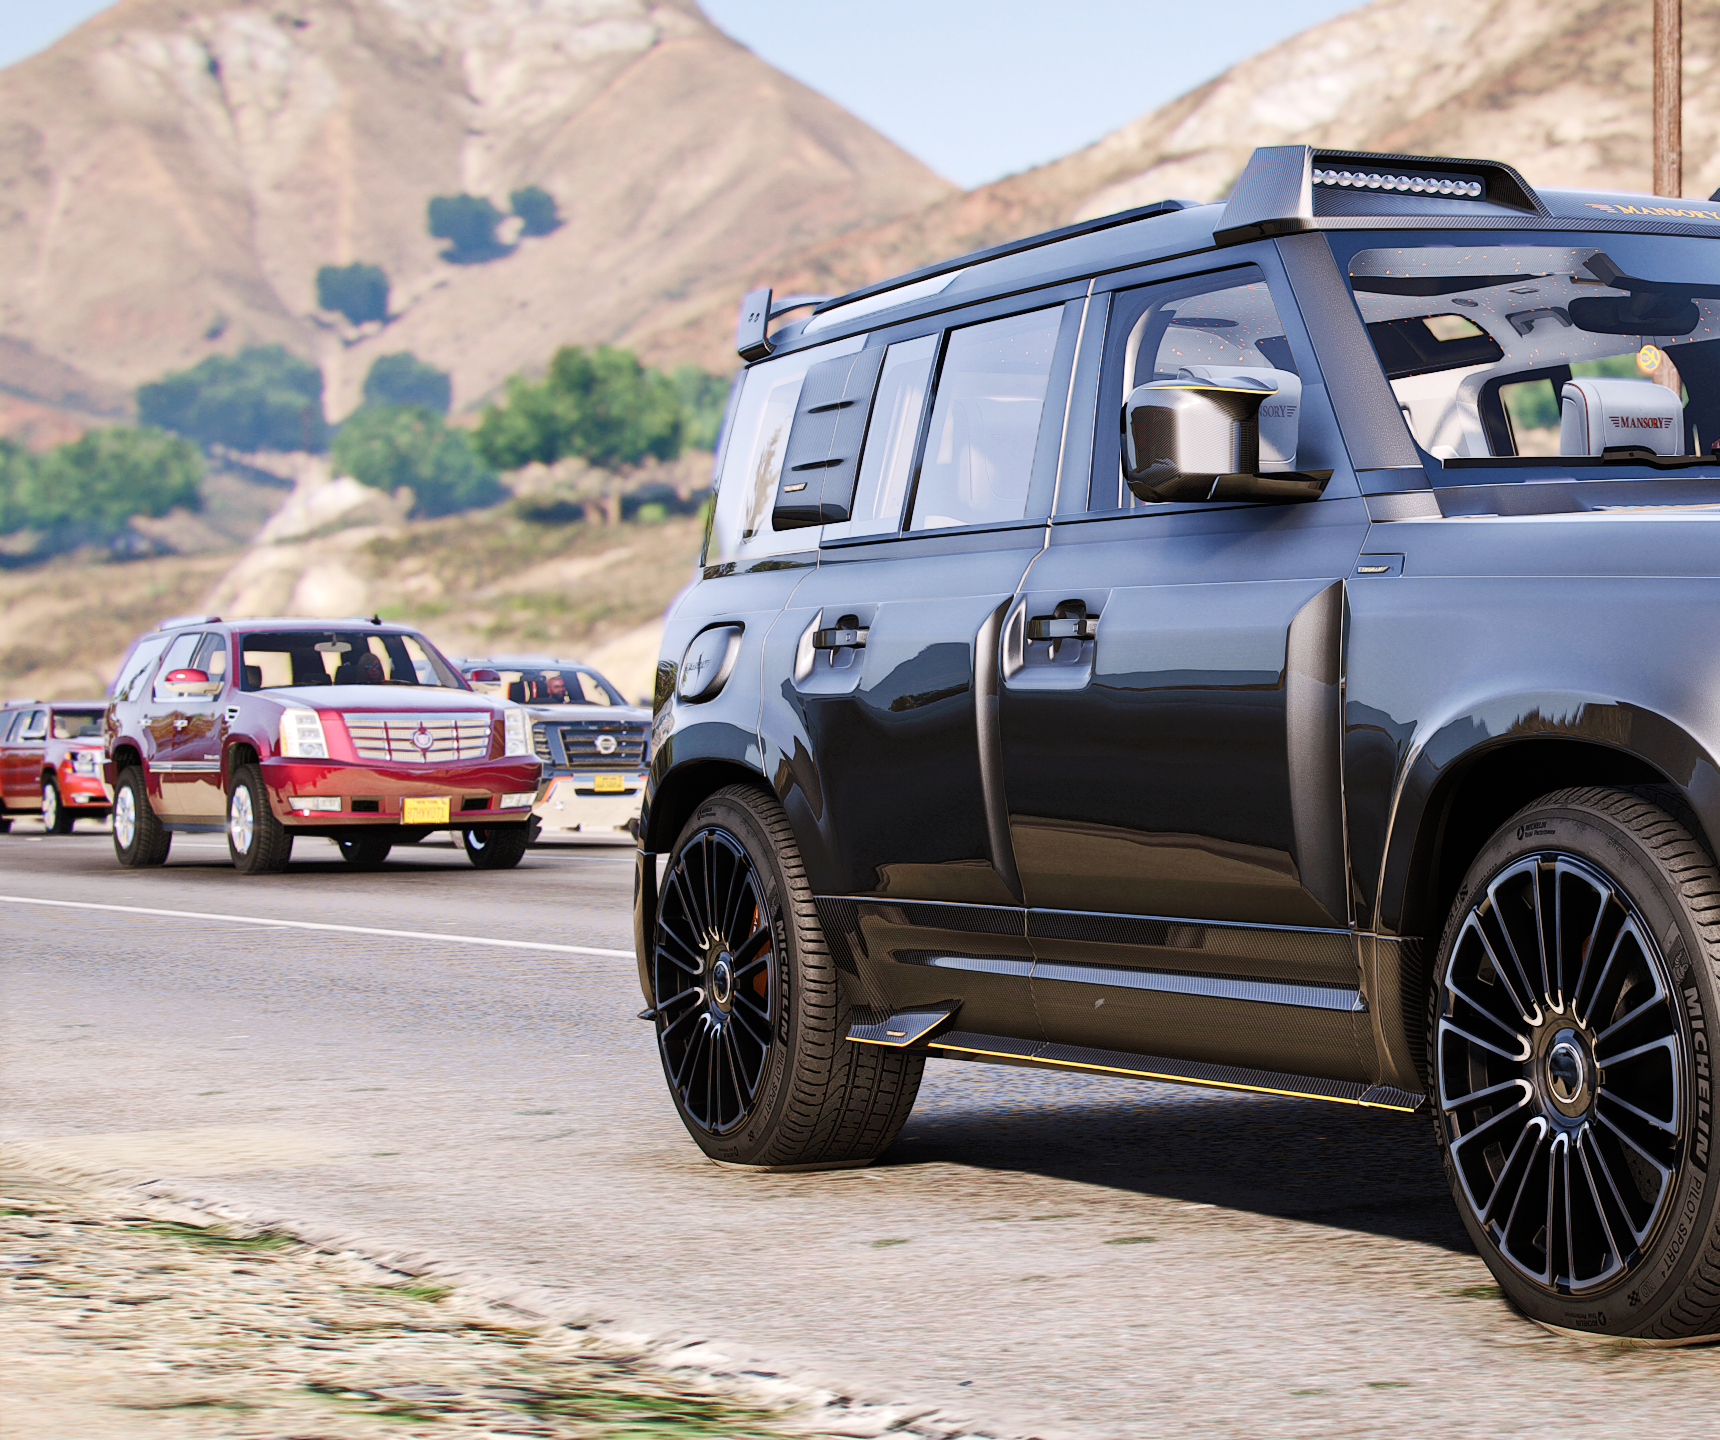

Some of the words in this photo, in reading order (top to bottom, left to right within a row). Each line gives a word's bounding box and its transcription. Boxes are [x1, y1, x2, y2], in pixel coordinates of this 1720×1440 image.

[1259, 405, 1287, 417] NSORY
[1621, 416, 1664, 428] MANSORY
[776, 919, 789, 1042] MICHELIN
[1426, 986, 1443, 1146] MICHELIN
[1684, 986, 1711, 1168] MICHELIN
[1683, 1176, 1702, 1224] PILOT
[1663, 1223, 1688, 1272] SPORT
